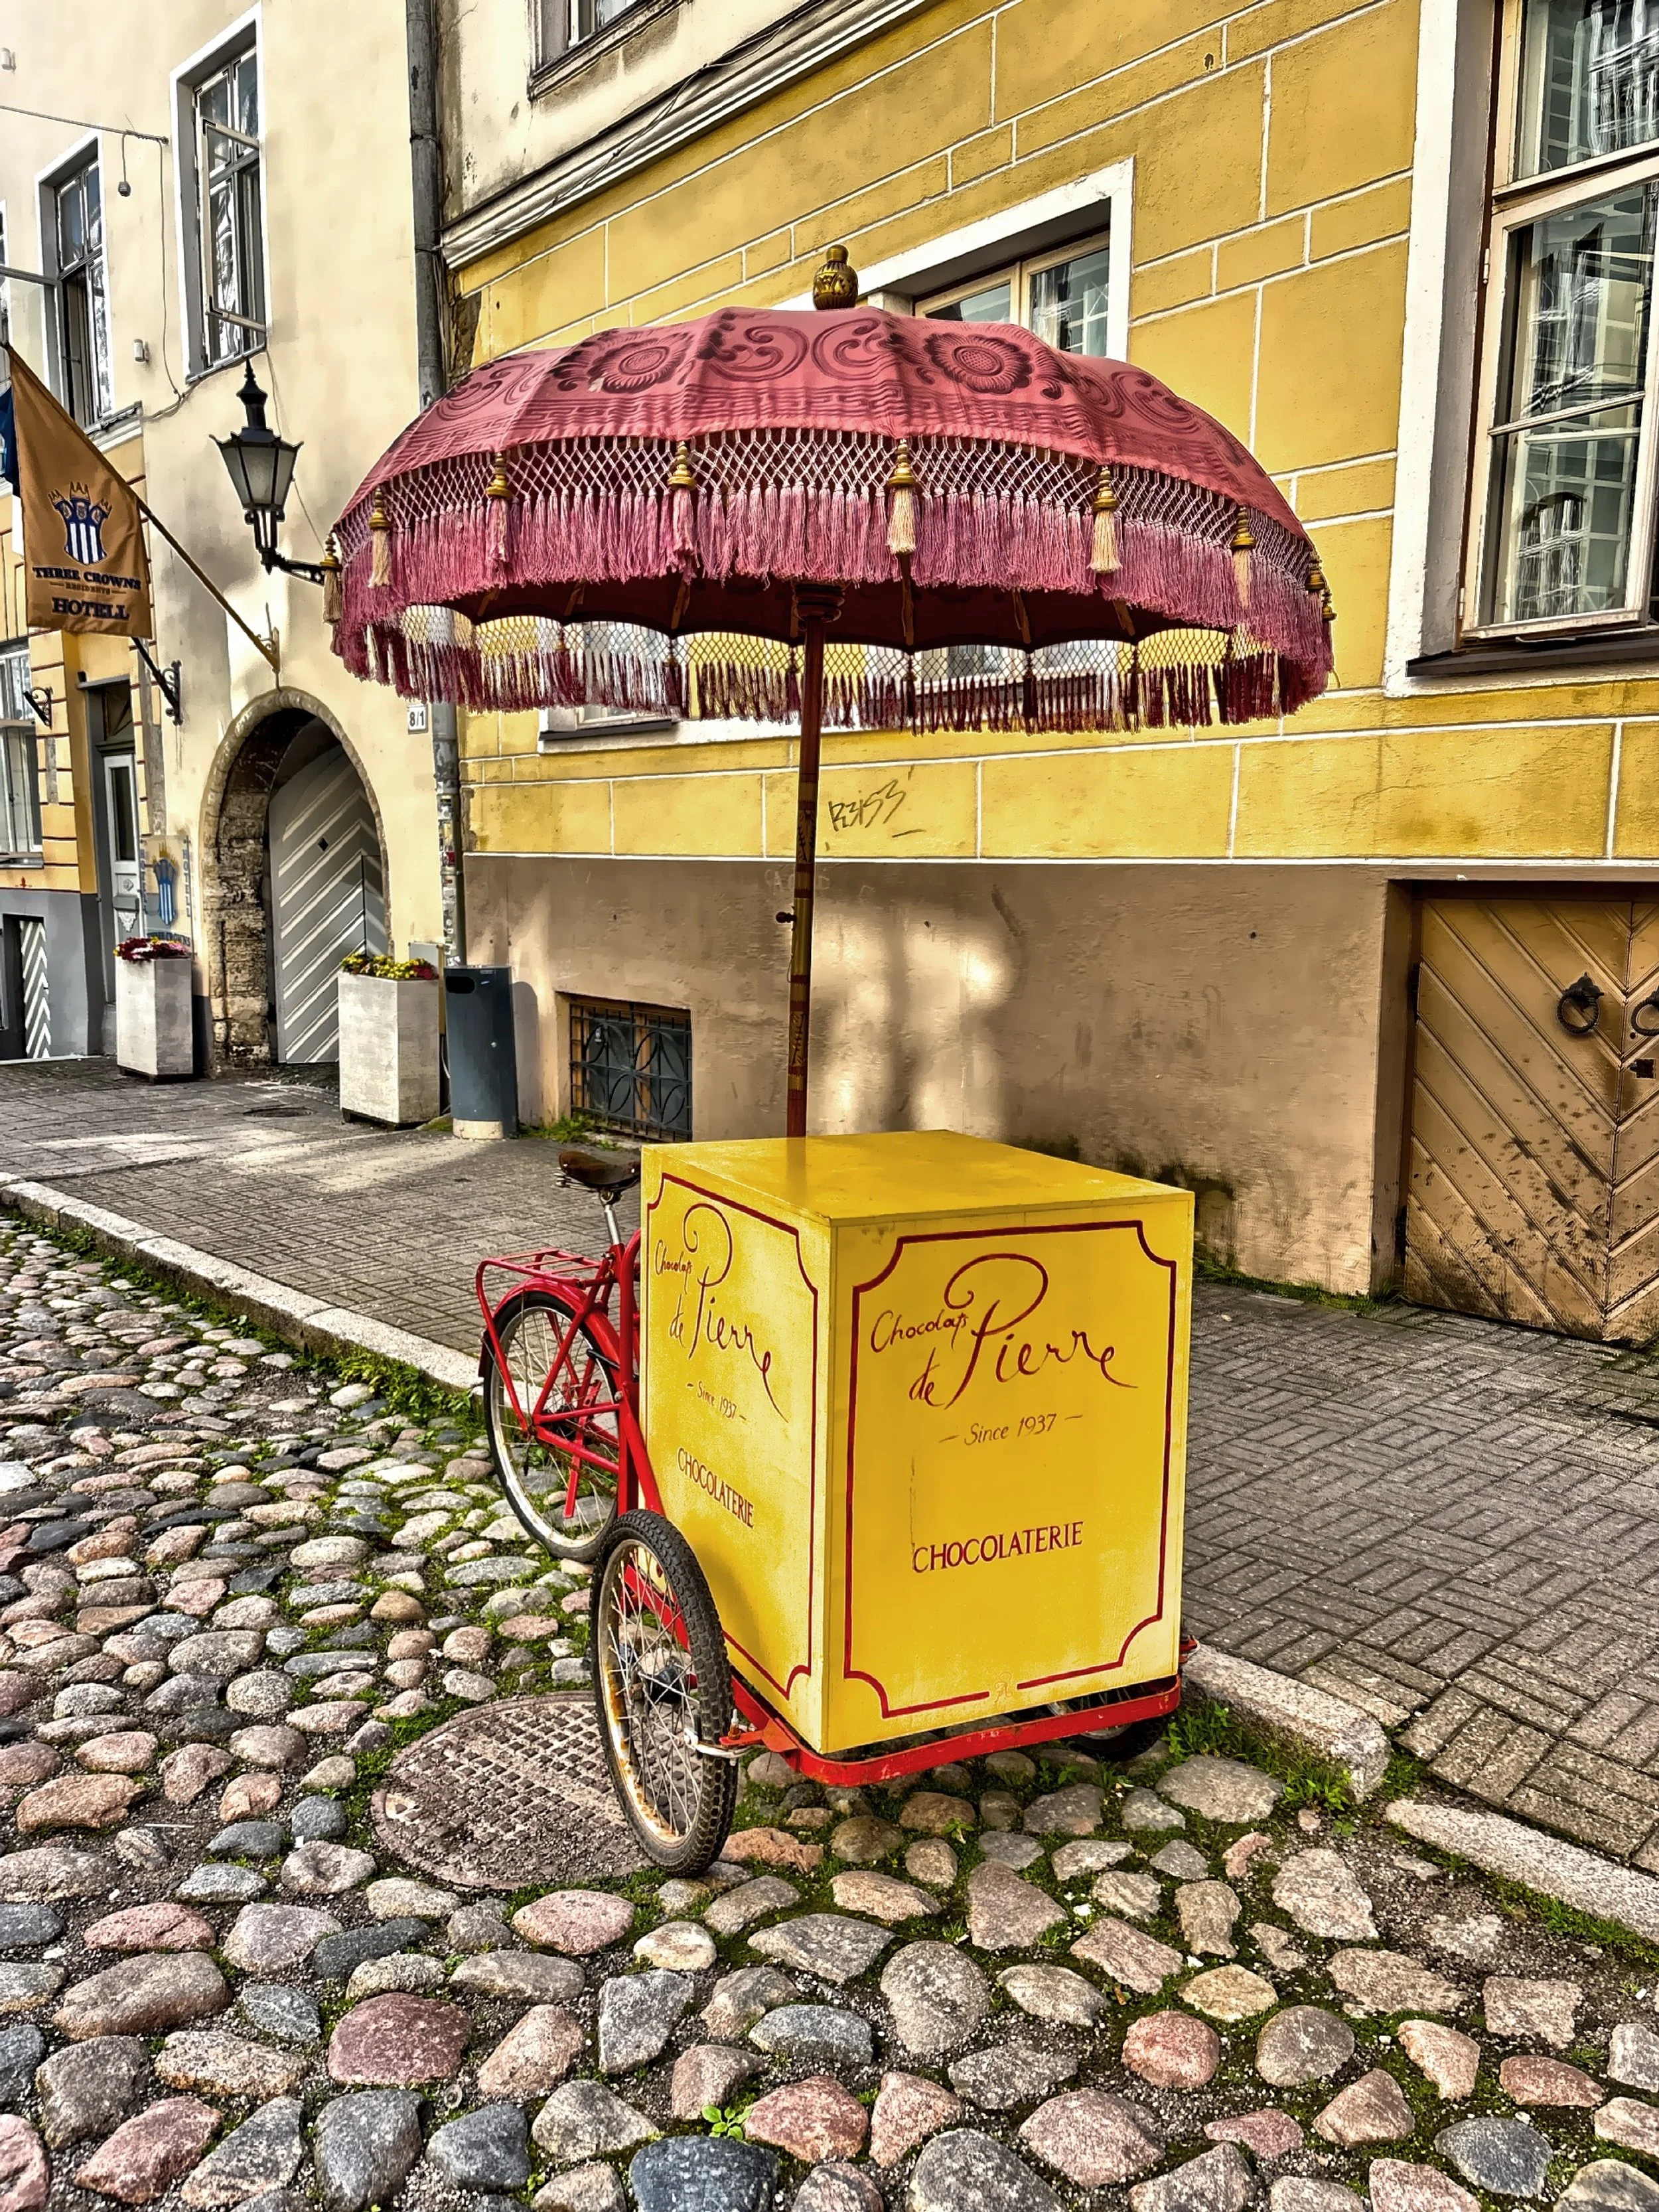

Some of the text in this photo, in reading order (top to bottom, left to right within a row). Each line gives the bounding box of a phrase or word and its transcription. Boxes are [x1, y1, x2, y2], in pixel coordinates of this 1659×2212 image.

[32, 567, 141, 591] THREE CROWNS
[52, 597, 130, 620] HOTELL
[409, 711, 425, 727] 8/1
[670, 1203, 789, 1424] de Pierre
[871, 1309, 968, 1353] Chocolats
[908, 1253, 1139, 1410] de Pierre
[698, 1380, 737, 1419] Since 1937
[964, 1413, 1057, 1445] Since 1937
[678, 1447, 754, 1528] CHOCOLATERIE
[913, 1521, 1084, 1574] CHOCOLATERIE
